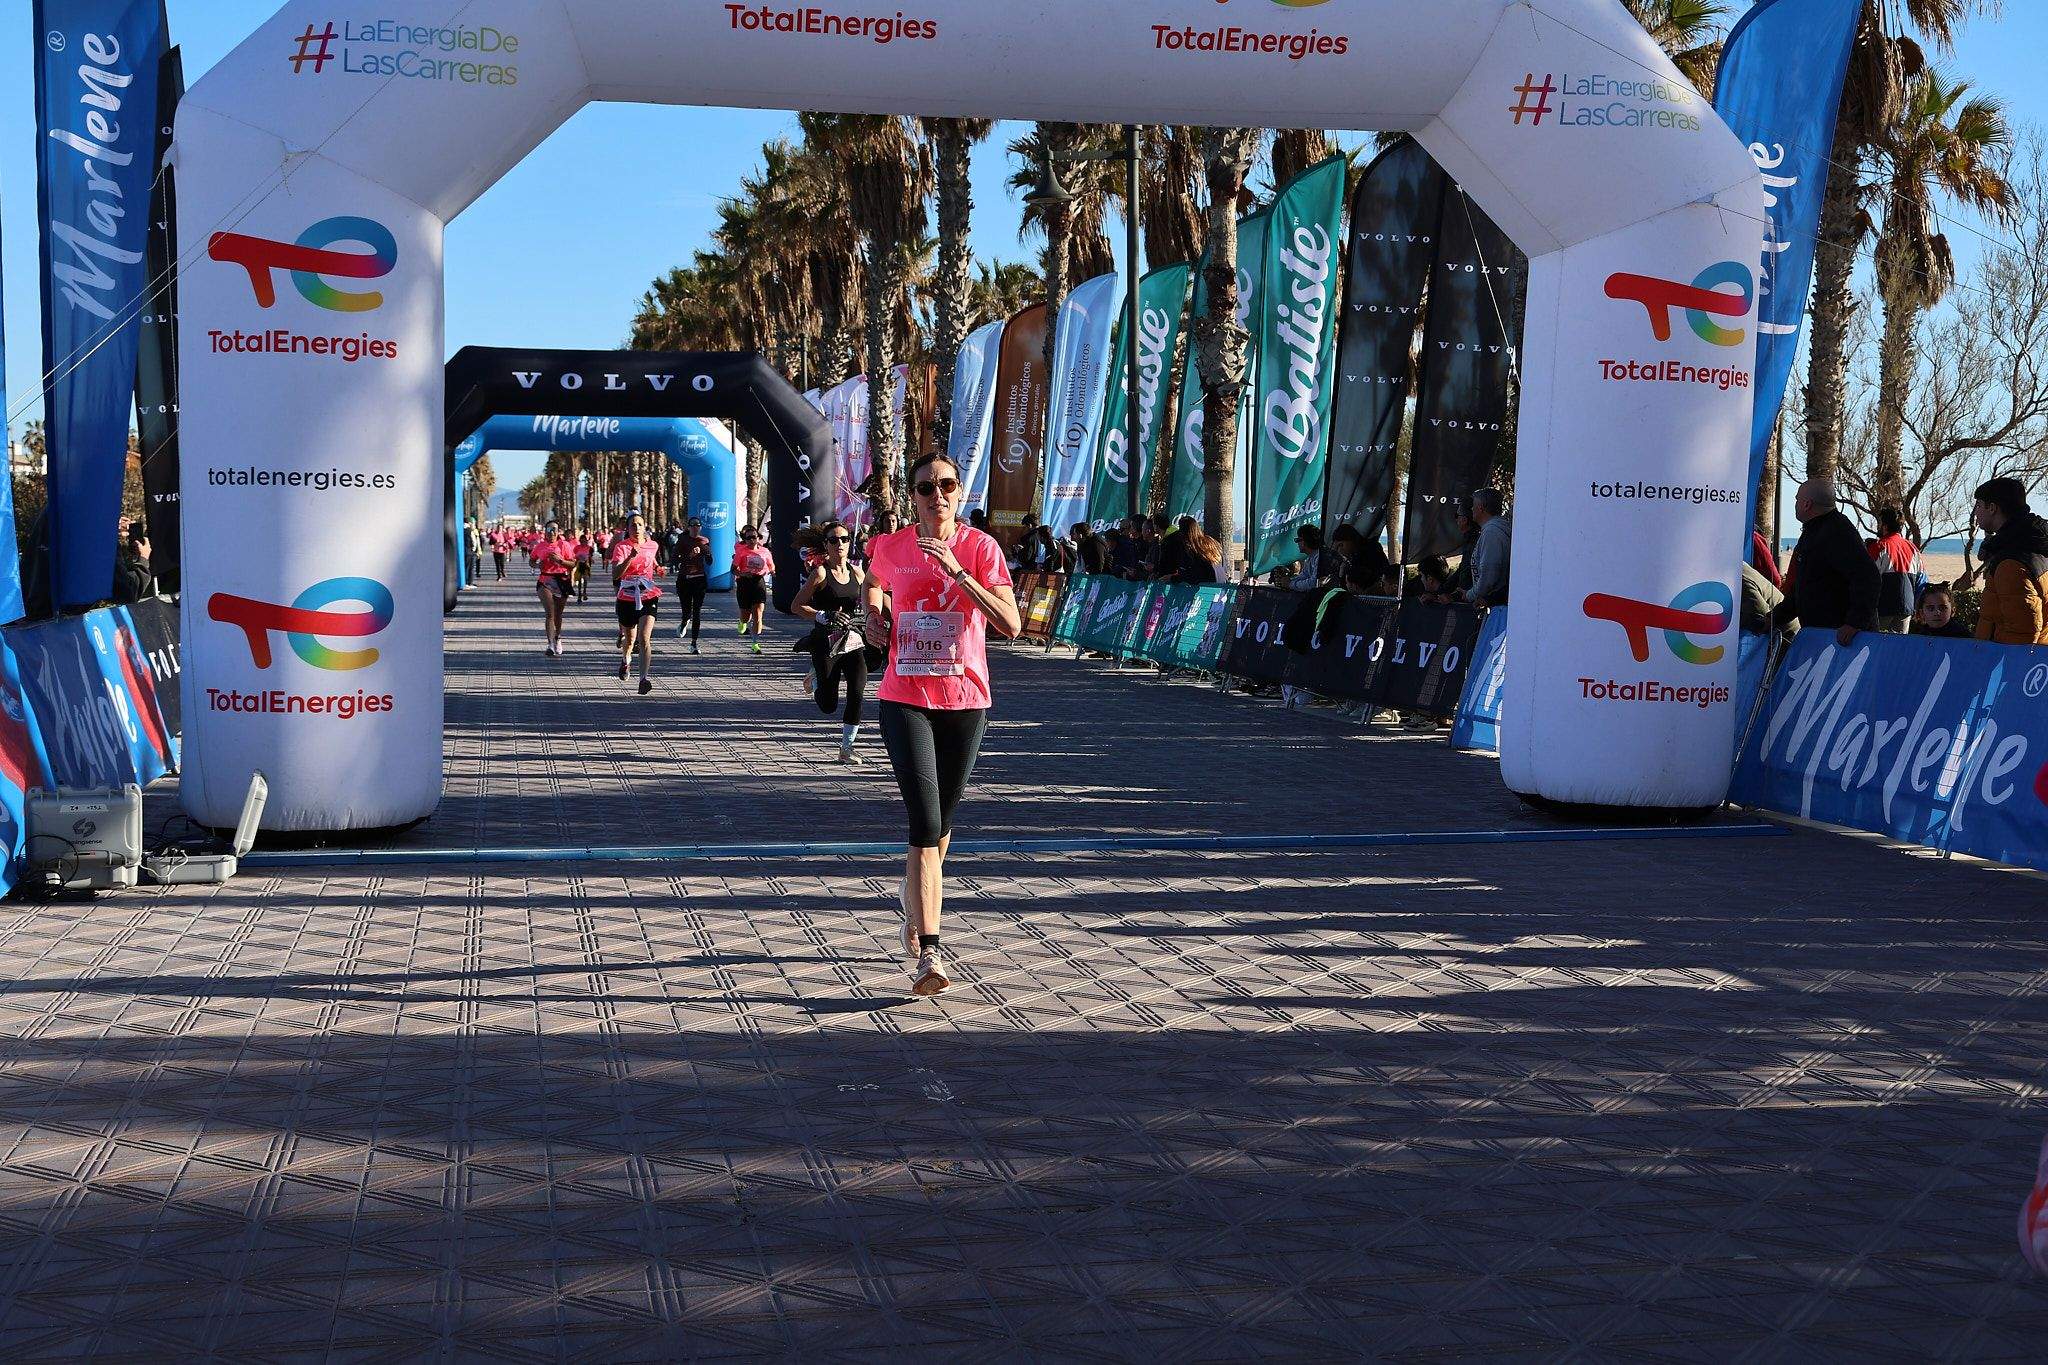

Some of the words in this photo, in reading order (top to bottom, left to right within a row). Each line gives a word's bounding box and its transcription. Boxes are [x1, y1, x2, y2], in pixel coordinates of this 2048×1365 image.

[725, 4, 938, 44] TotalEnergies
[1151, 24, 1349, 60] TotalEnergies
[343, 48, 518, 86] LasCarreras
[1559, 101, 1701, 132] LasCarreras
[50, 33, 143, 320] Marlene
[1359, 232, 1431, 243] VOLVO
[1446, 262, 1510, 275] VOLV
[207, 328, 398, 363] TotalEnergies
[1265, 222, 1331, 464] Batiste
[1438, 341, 1514, 355] VOLVO
[511, 371, 715, 391] VOLVO
[1075, 343, 1091, 419] Odontológicos
[1598, 358, 1749, 391] TotalEnergies
[1005, 384, 1018, 434] Institutos
[1016, 361, 1032, 436] Odontológicos
[1065, 367, 1077, 418] Institutos
[532, 414, 621, 446] Marlene
[1429, 417, 1500, 431] VOLVO
[207, 467, 396, 491] totalenergies.es
[1590, 480, 1741, 505] totalenergies.es
[1260, 498, 1321, 530] Batiste
[1422, 494, 1462, 505] VOL
[915, 640, 943, 651] 016
[1235, 617, 1322, 650] VOLO
[1345, 634, 1460, 673] VOLVO
[206, 687, 394, 720] TotalEnergies
[1578, 677, 1730, 709] TotalEnergies
[1760, 642, 2027, 832] Marlene
